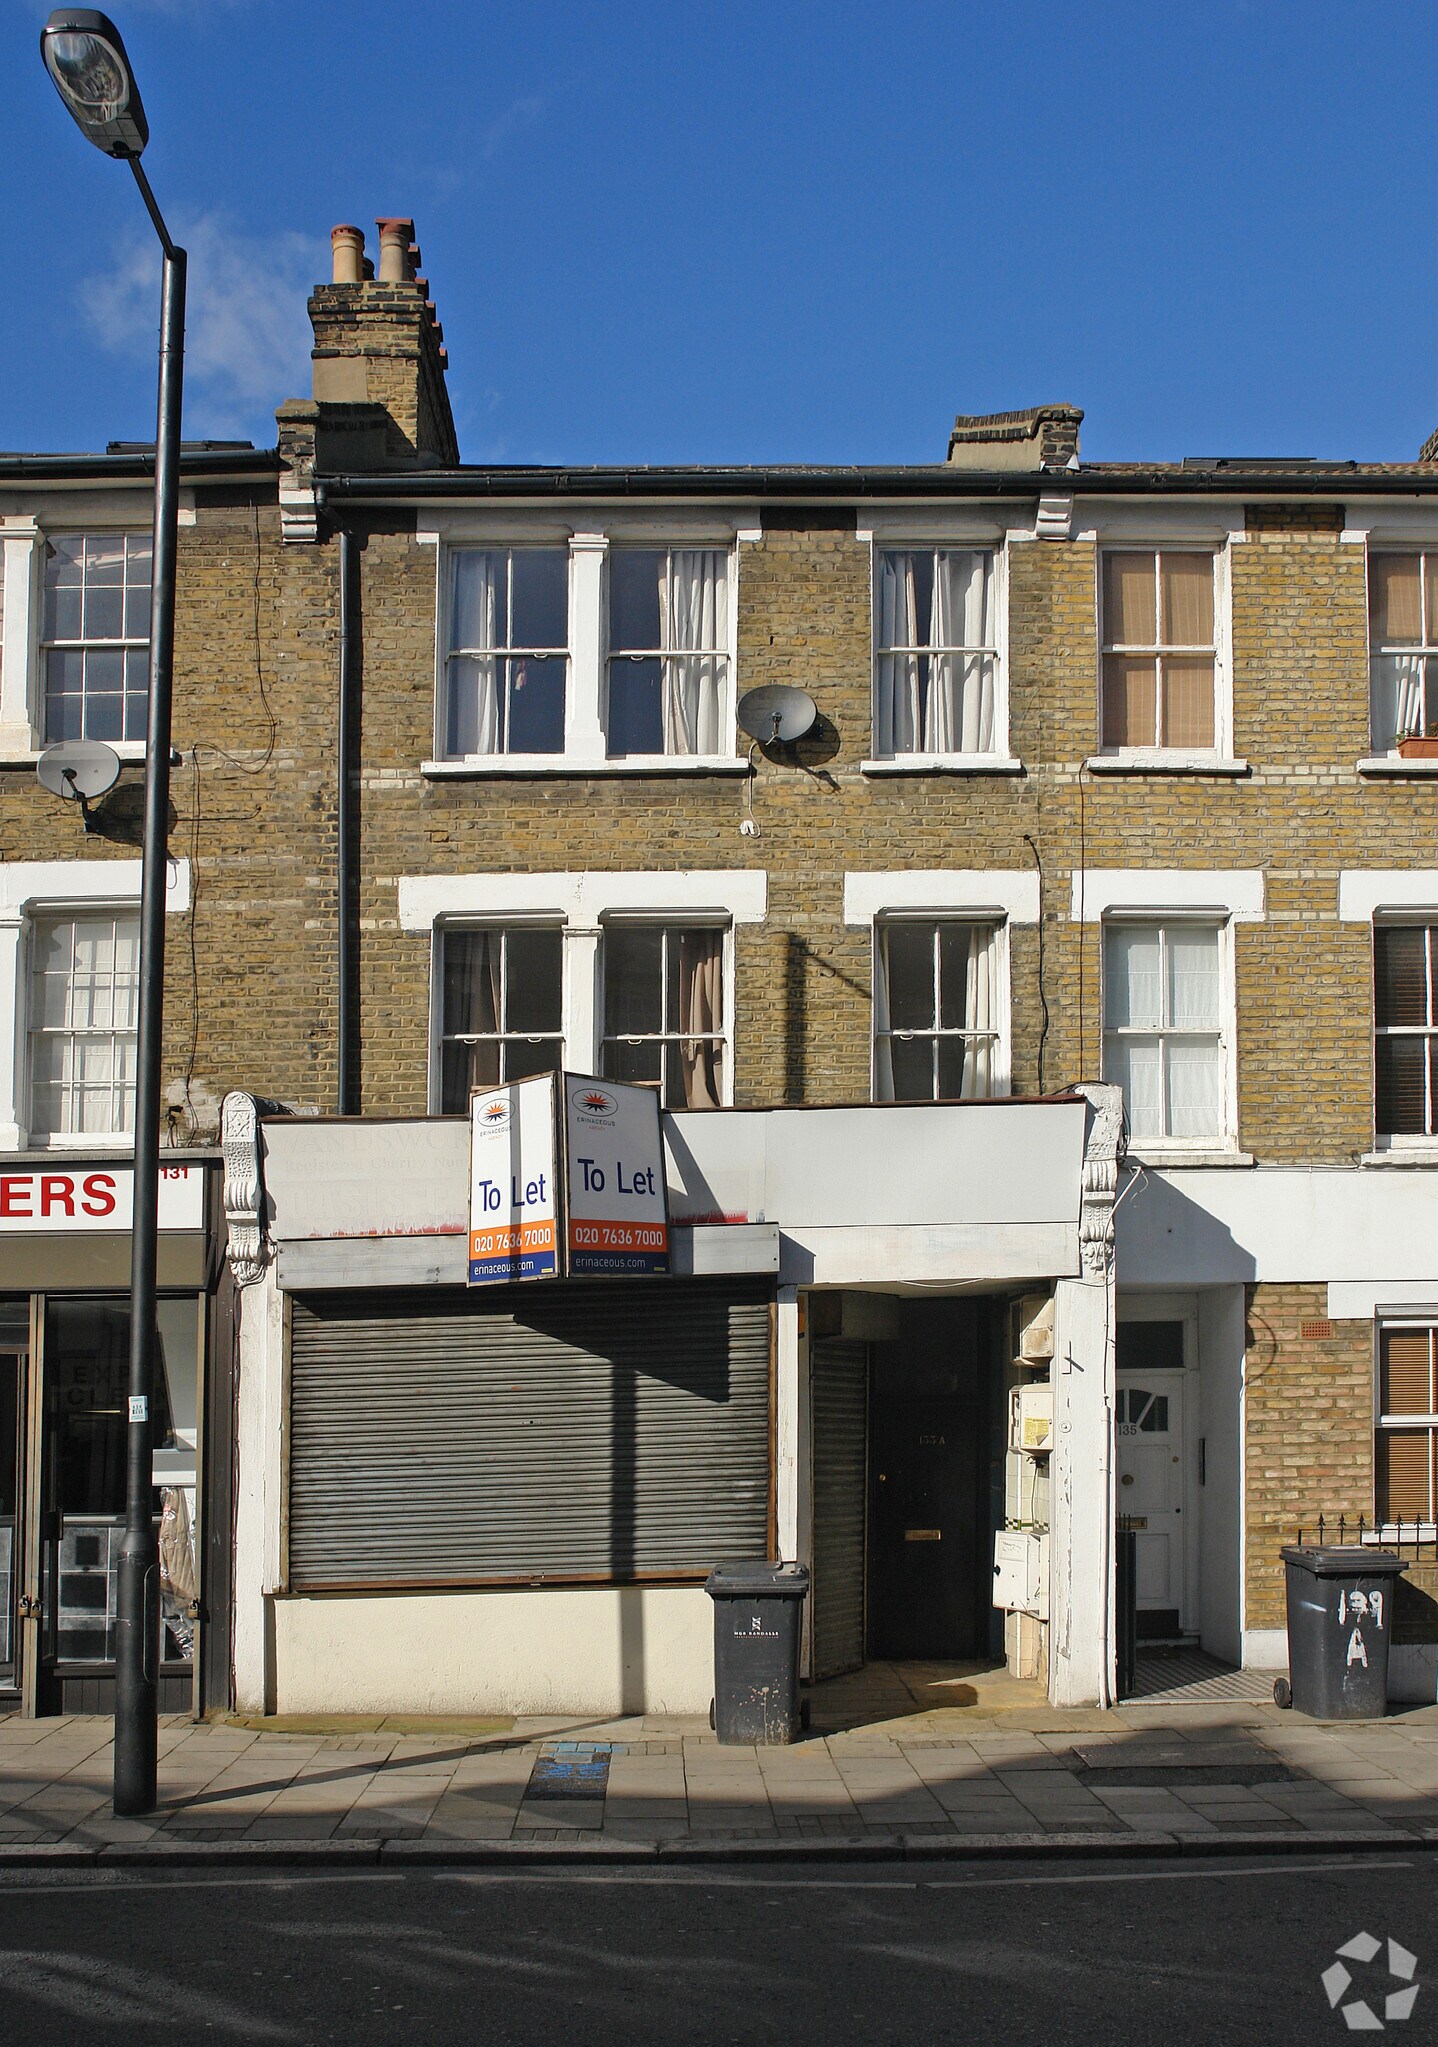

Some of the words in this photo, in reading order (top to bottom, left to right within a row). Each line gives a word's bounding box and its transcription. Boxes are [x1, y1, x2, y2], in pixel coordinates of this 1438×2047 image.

[577, 1116, 616, 1127] ERINACEOUS
[480, 1125, 512, 1137] ERINACEOUS
[160, 1166, 189, 1180] 131
[577, 1158, 605, 1192] To
[617, 1161, 656, 1196] Let
[0, 1174, 117, 1217] ERS
[479, 1179, 501, 1212] To
[512, 1174, 546, 1208] Let
[474, 1235, 493, 1253] 020
[496, 1231, 523, 1250] 7636
[524, 1227, 551, 1246] 7000
[575, 1227, 599, 1244] 020
[602, 1228, 633, 1245] 7636
[635, 1230, 663, 1246] 7000
[474, 1259, 535, 1276] erinaceous.com
[575, 1257, 646, 1269] erinaceous.com
[1119, 1424, 1137, 1436] 135
[1346, 1627, 1369, 1668] A
